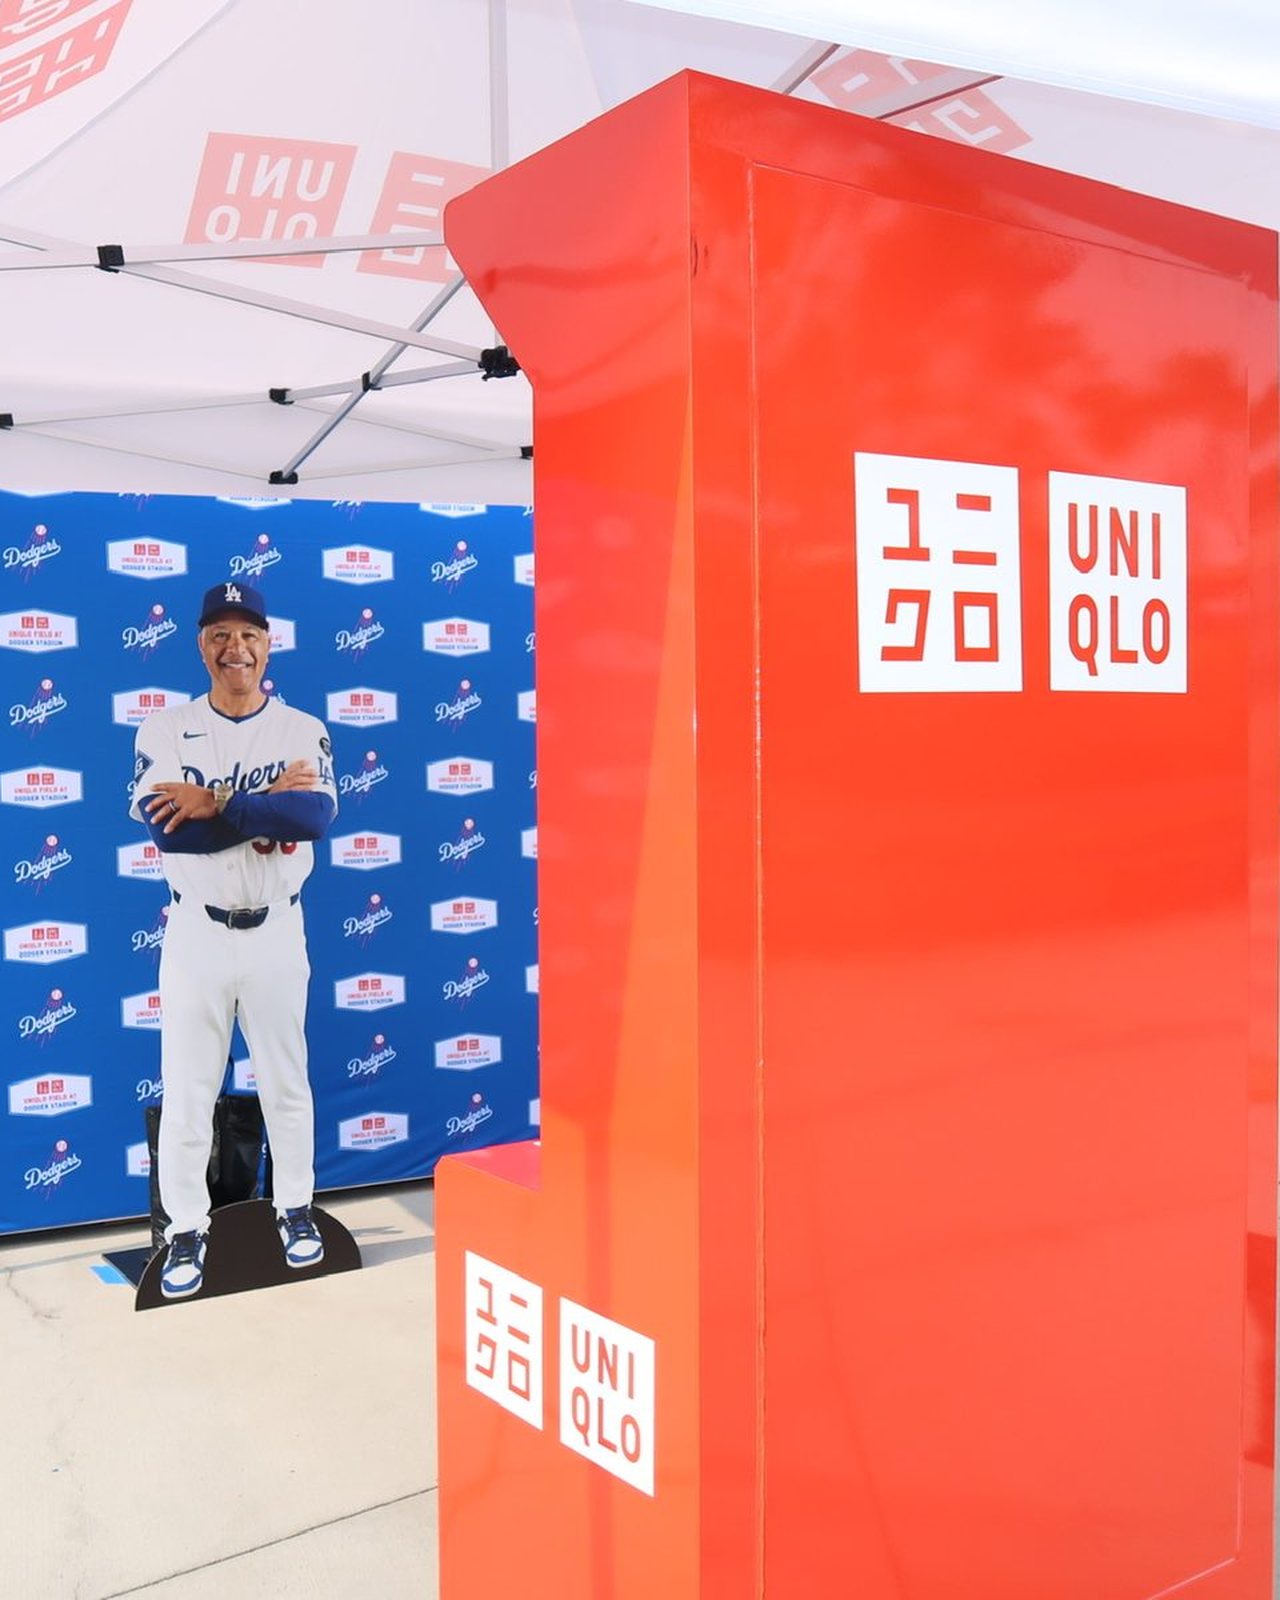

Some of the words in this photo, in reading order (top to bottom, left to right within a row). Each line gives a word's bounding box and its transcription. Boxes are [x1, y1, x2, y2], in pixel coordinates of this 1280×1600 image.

[3, 539, 61, 567] Dodgers
[1068, 502, 1161, 580] UNI
[230, 548, 281, 576] Dodgers
[432, 554, 477, 581] Dodgers
[225, 582, 242, 602] LA
[123, 618, 176, 648] Dodgers
[336, 622, 384, 650] Dodgers
[1068, 593, 1170, 676] QLO
[10, 693, 67, 725] Dodgers
[436, 693, 481, 721] Dodgers
[340, 766, 388, 793] Dodgers
[439, 833, 485, 861] Dodgers
[15, 849, 71, 882] Dodgers
[343, 907, 392, 936] Dodgers
[19, 950, 44, 958] DODGER
[443, 970, 489, 1000] Dodgers
[19, 1003, 76, 1037] Dodgers
[348, 1046, 396, 1077] Dodgers
[24, 1103, 49, 1111] DODGER
[50, 1101, 77, 1109] STADIUM
[446, 1105, 492, 1136] Dodgers
[25, 1154, 81, 1189] Dodgers
[572, 1323, 634, 1400] UNI
[572, 1386, 641, 1464] QLO
